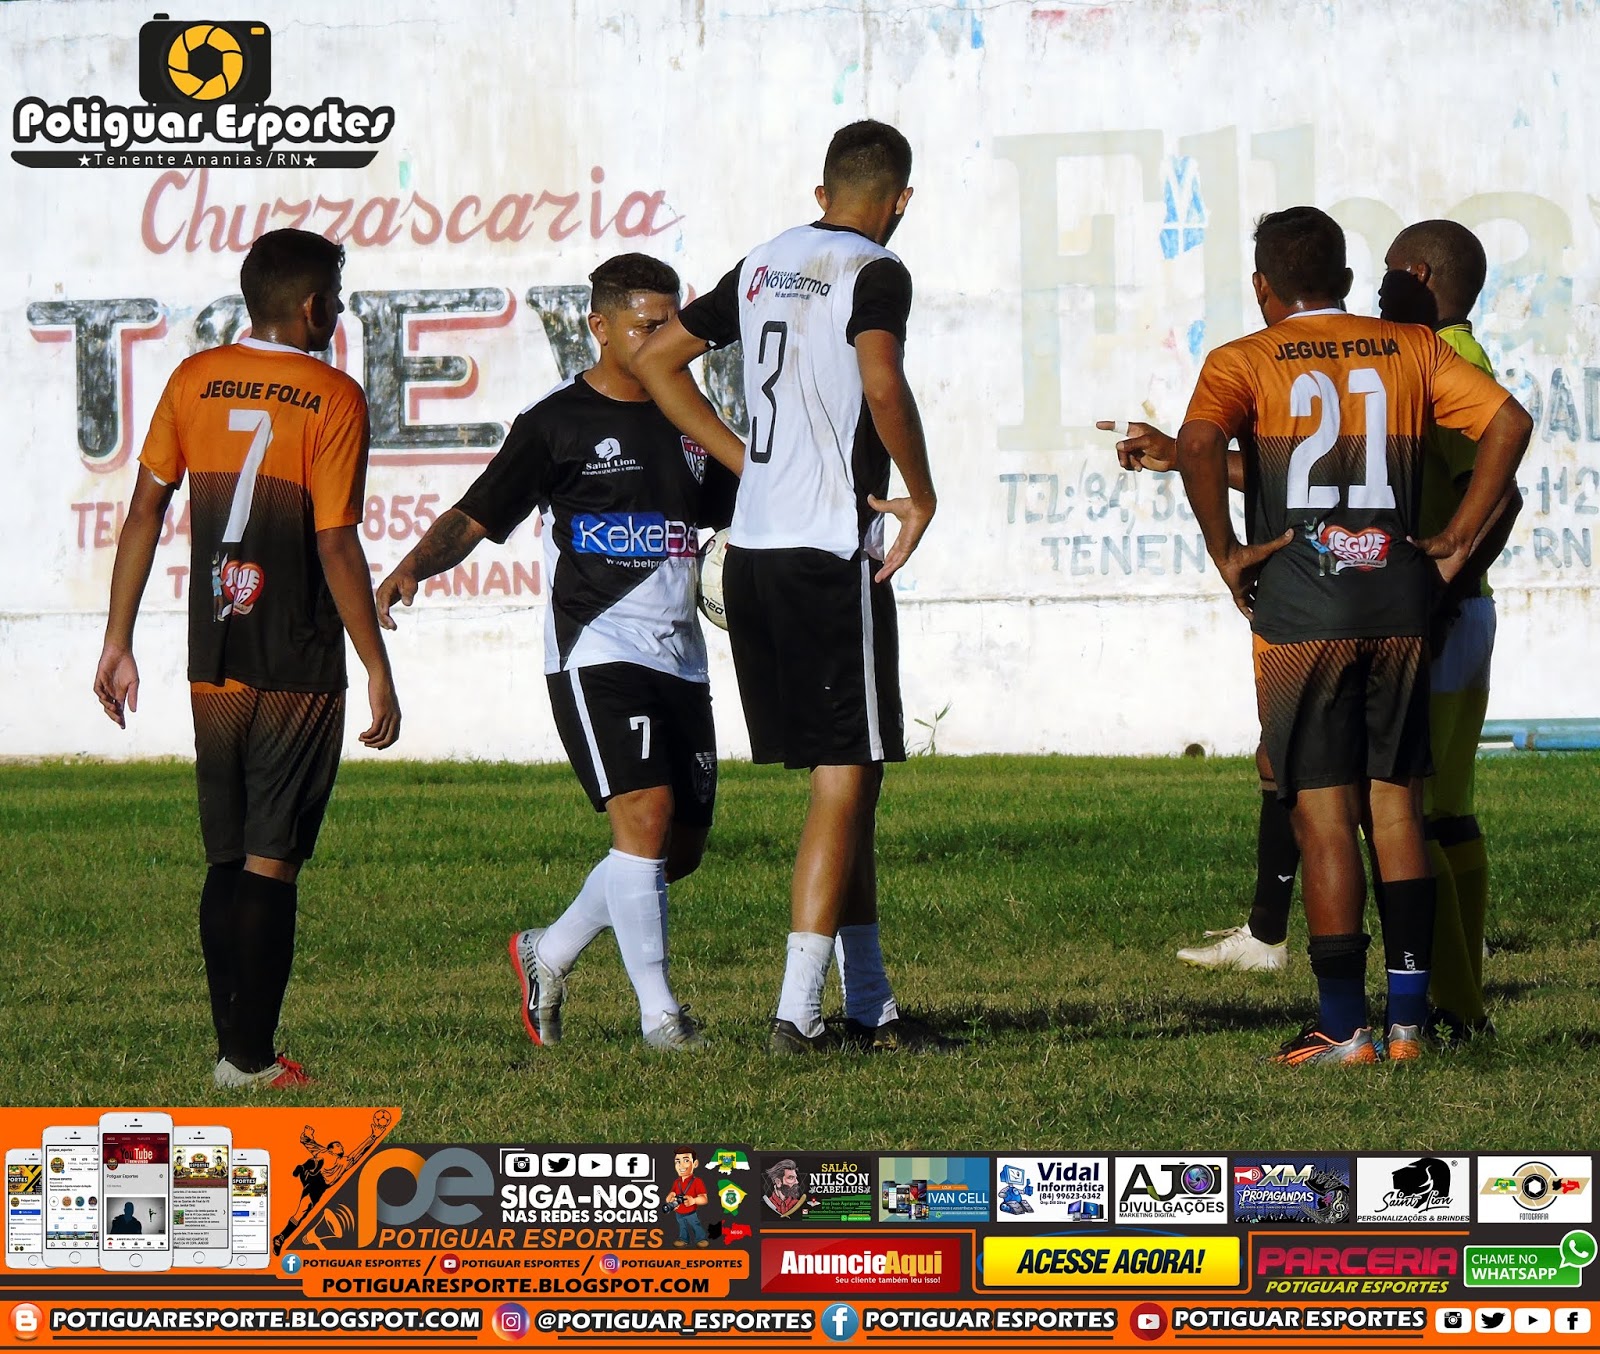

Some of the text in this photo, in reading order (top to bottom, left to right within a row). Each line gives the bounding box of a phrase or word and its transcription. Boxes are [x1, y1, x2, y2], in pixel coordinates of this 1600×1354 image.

[1274, 338, 1401, 361] JEGUE FOLIA
[200, 380, 322, 414] JEGUE FOLIA
[750, 321, 788, 463] 3
[1287, 368, 1396, 509] 21
[222, 409, 274, 543] 7
[614, 458, 636, 466] Lion
[1041, 534, 1206, 575] TENEN
[424, 561, 541, 598] ANAN
[629, 715, 651, 760] 7
